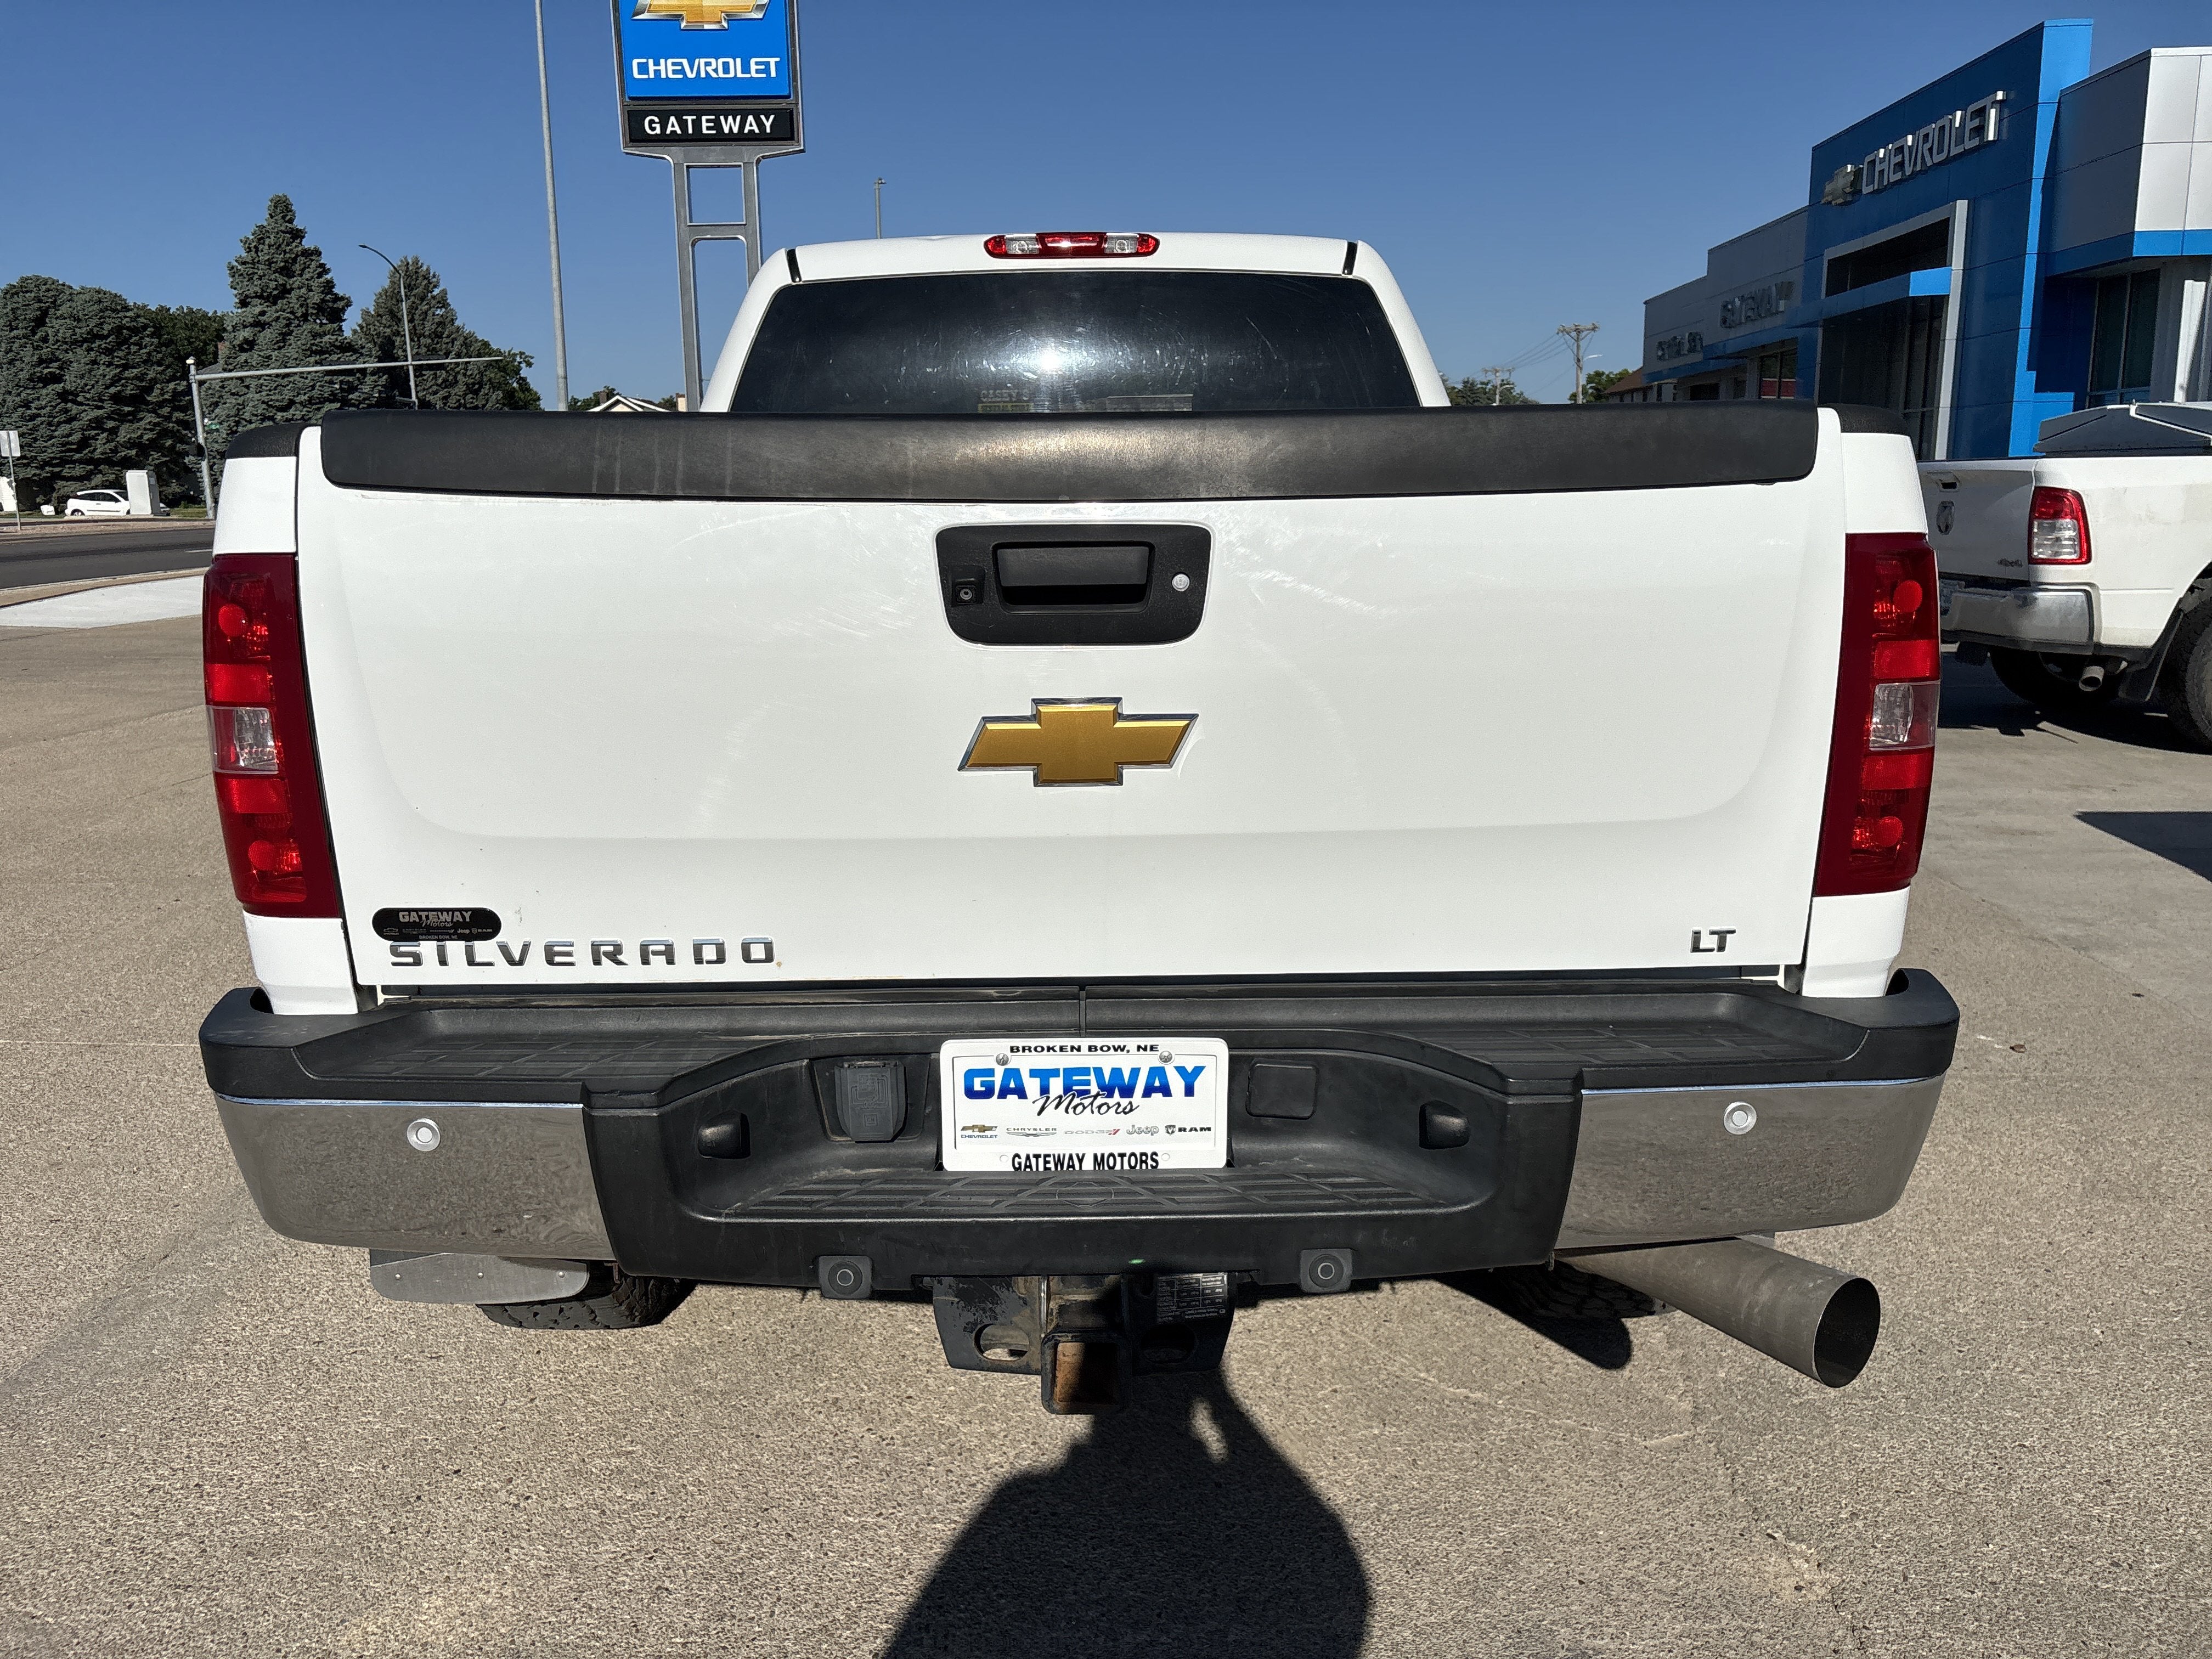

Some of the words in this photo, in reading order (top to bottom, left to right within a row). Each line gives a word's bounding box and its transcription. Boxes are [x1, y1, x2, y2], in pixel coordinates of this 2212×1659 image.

[632, 57, 780, 78] CHEVROLET
[644, 115, 776, 135] GATEWAY
[1863, 91, 2006, 195] CHEVROLET
[398, 911, 472, 922] GATEWAY
[420, 919, 454, 927] Motors
[1690, 928, 1736, 953] LT
[389, 936, 775, 967] SILVERADO
[1087, 1045, 1130, 1054] BOW,
[964, 1065, 1206, 1100] GATEWAY
[1032, 1091, 1140, 1116] Motors
[1126, 1124, 1159, 1136] Jeep
[1012, 1153, 1086, 1171] GATEWAY
[1093, 1152, 1160, 1170] MOTORS
